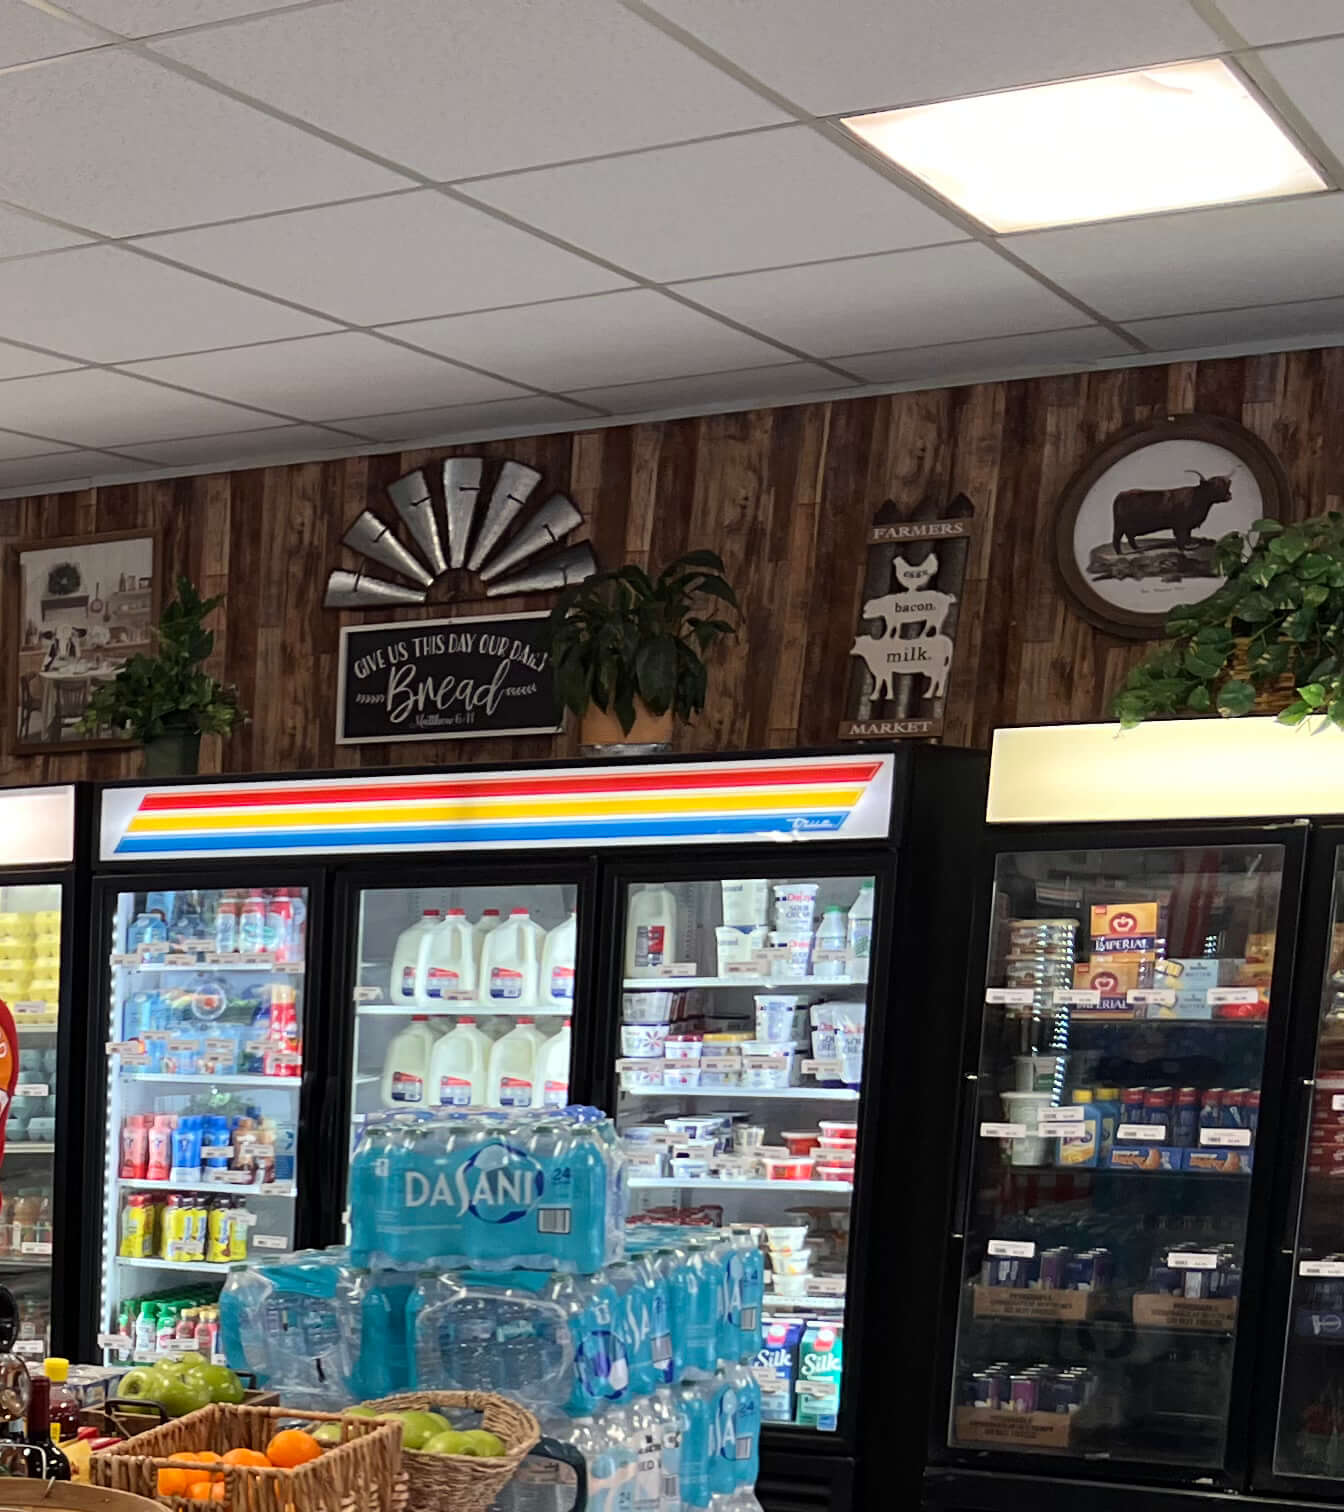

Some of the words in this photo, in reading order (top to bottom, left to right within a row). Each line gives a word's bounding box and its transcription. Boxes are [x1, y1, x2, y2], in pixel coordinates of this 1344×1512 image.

[872, 522, 964, 540] FARMERS
[895, 601, 936, 613] bacon.
[353, 653, 387, 679] GIVE
[387, 642, 409, 664] US
[412, 635, 445, 657] THIS
[448, 633, 477, 653] DAY
[479, 633, 508, 658] OUR
[886, 646, 933, 664] milk.
[386, 658, 511, 723] Bread
[849, 721, 934, 735] MARKET
[786, 815, 833, 829] True
[1095, 938, 1149, 952] IMPERIAL
[552, 1167, 571, 1182] 24
[404, 1161, 535, 1219] DASANI
[755, 1348, 793, 1369] Silk
[801, 1353, 842, 1376] Silk
